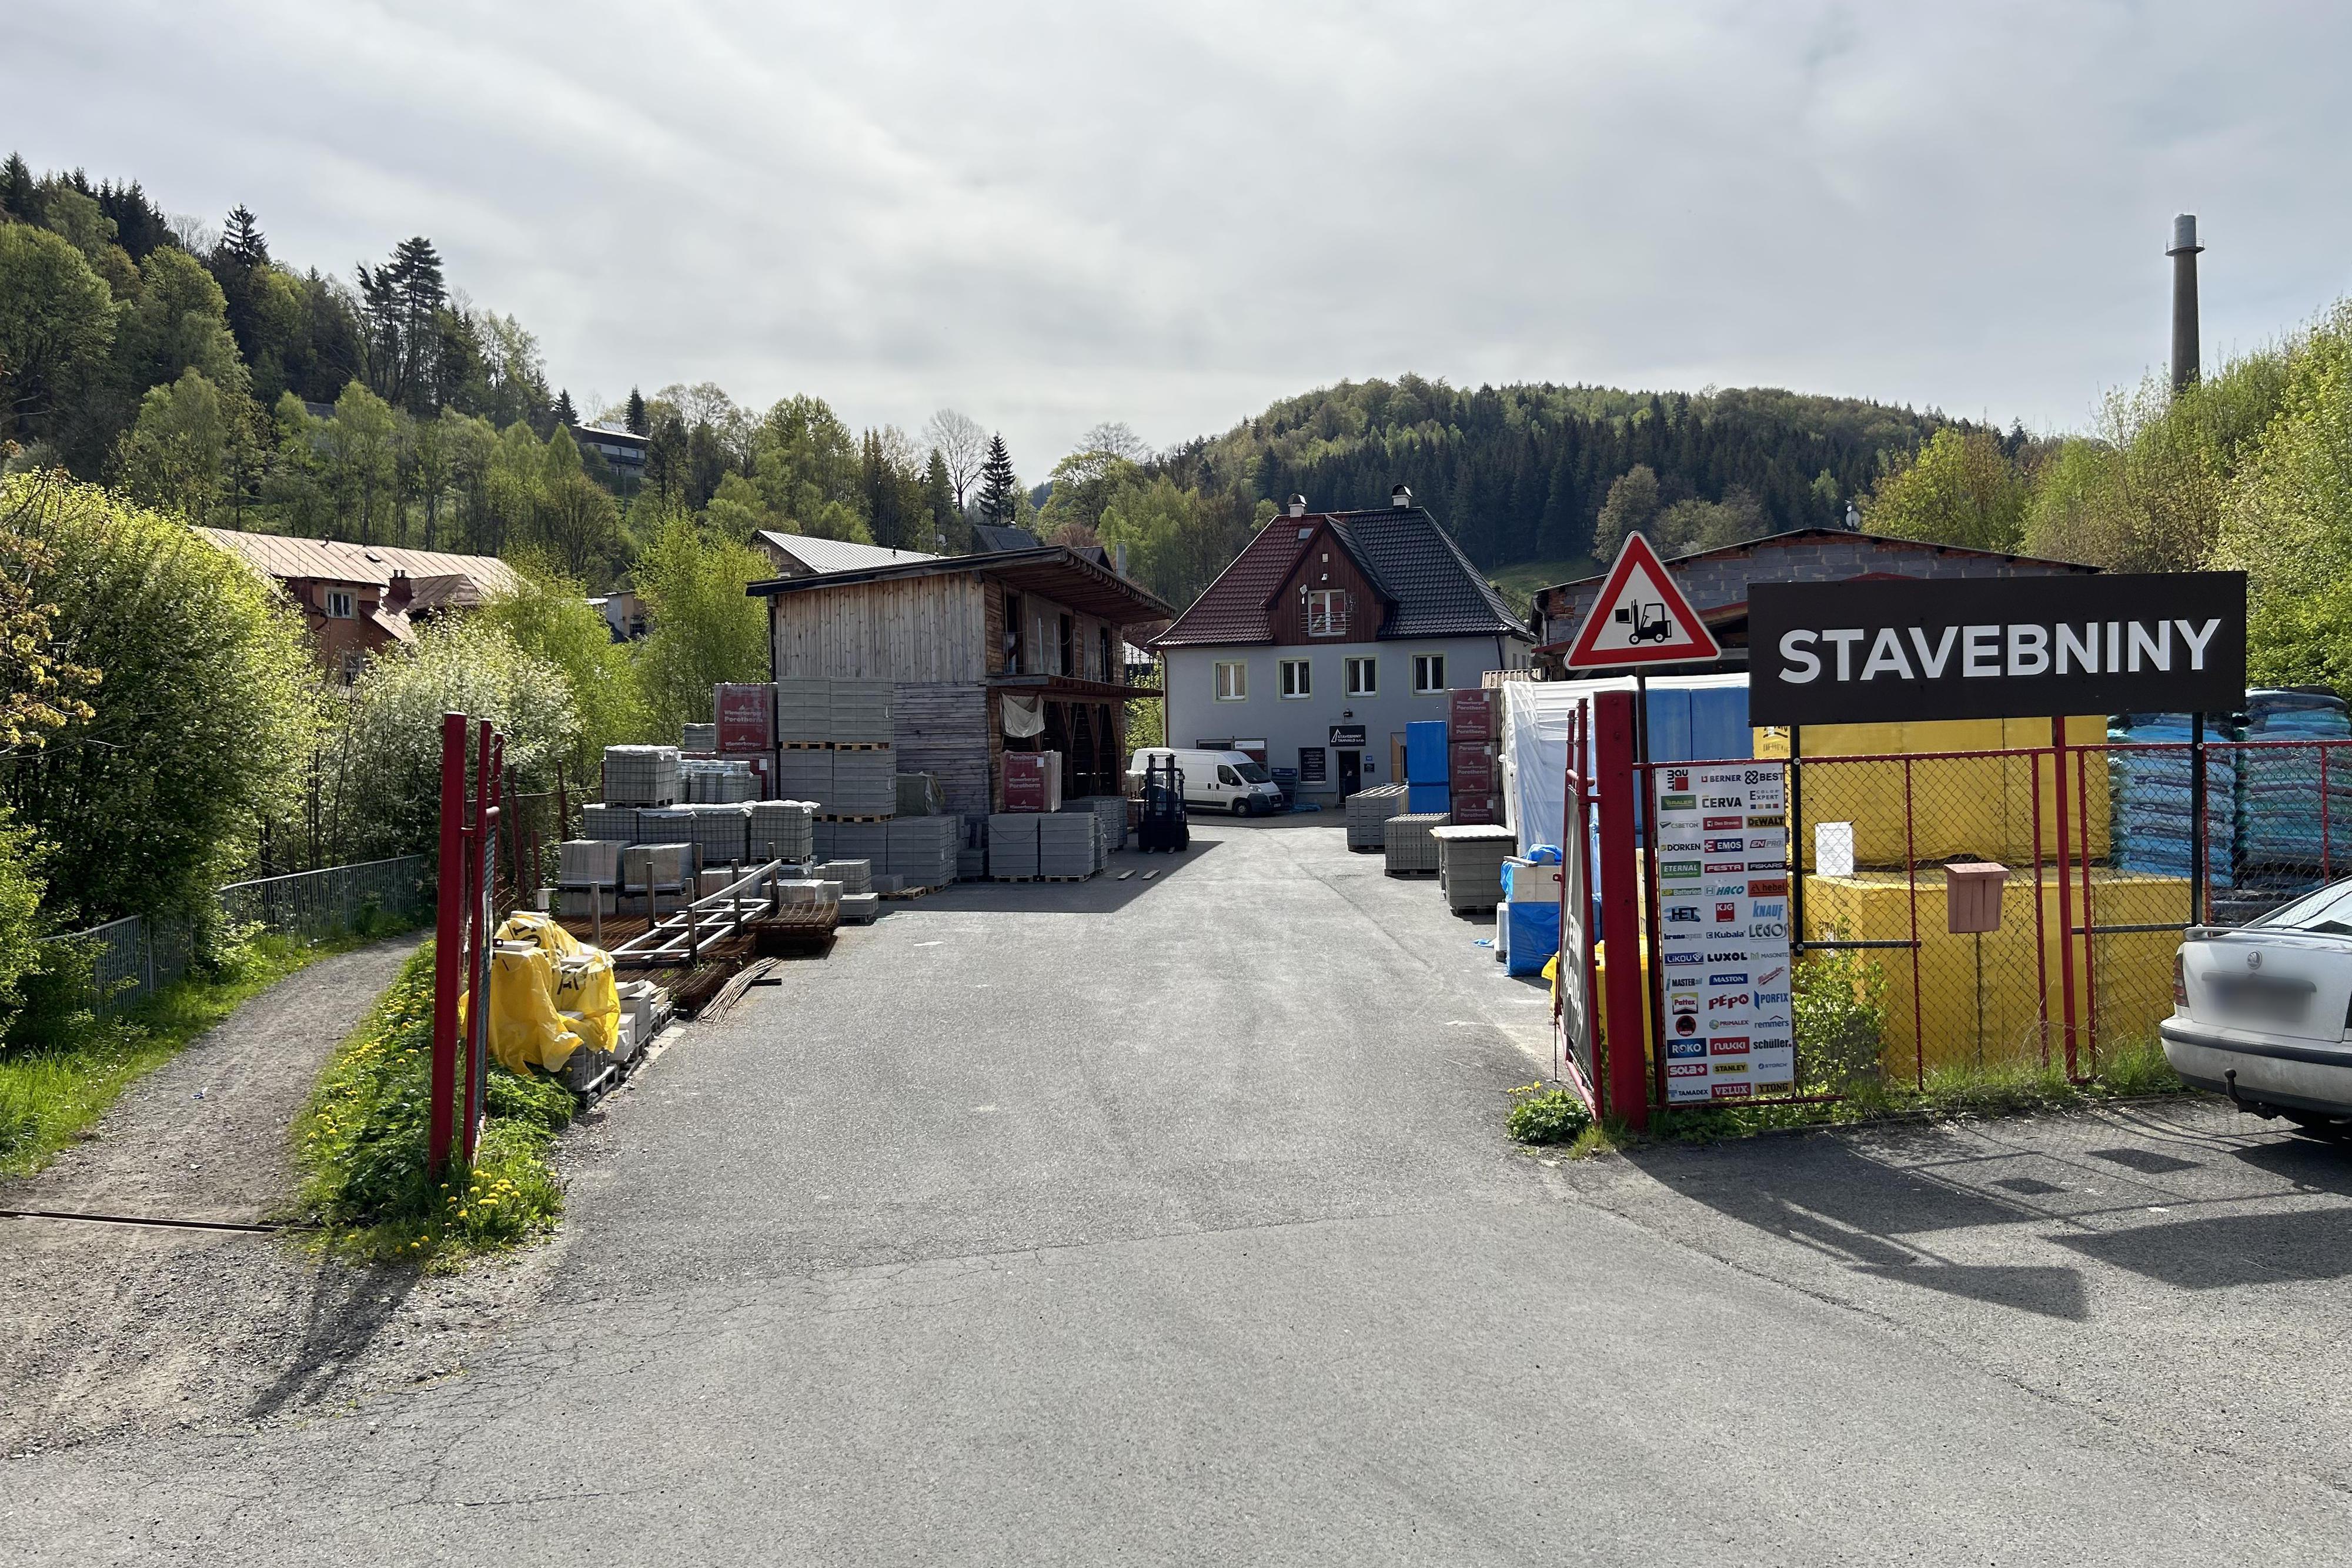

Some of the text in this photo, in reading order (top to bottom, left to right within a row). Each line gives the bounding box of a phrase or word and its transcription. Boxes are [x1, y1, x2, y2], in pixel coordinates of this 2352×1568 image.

[1778, 618, 2221, 684] STAVEBNINY
[1759, 773, 1784, 781] BEST
[1750, 791, 1779, 800] EXPERT
[1702, 797, 1742, 808] CERVA
[1717, 841, 1742, 850] EMOS
[1716, 885, 1745, 895] HACO
[1762, 883, 1785, 891] hebel
[1671, 907, 1698, 920] HET
[1707, 952, 1748, 962] LUXOL
[1760, 992, 1789, 1004] PORFIX
[1672, 1044, 1702, 1054] ROKO
[1714, 1085, 1748, 1095] VELUX
[1758, 1082, 1789, 1092] YTONG
